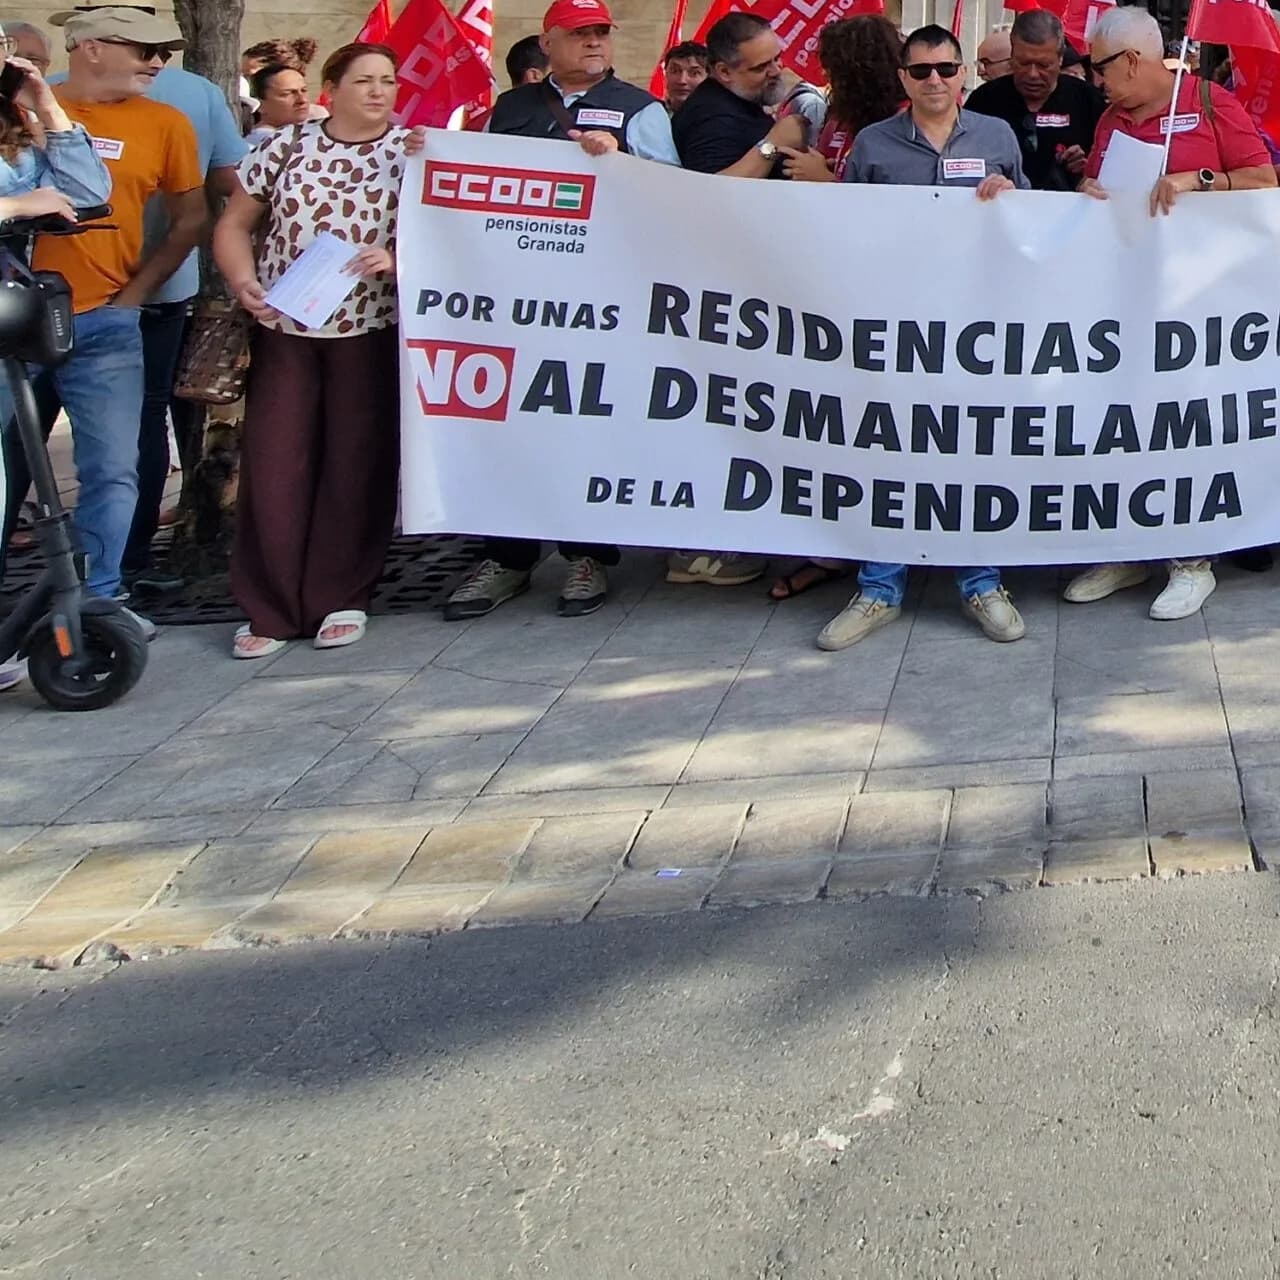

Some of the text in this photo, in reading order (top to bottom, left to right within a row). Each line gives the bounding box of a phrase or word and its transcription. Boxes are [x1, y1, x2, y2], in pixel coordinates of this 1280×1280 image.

[431, 171, 553, 207] CCOO
[485, 218, 587, 236] pensionistas
[517, 235, 585, 254] Granada
[416, 288, 495, 324] POR
[512, 297, 620, 331] UNAS
[647, 282, 1121, 375] RESIDENCIAS
[409, 346, 508, 410] NO
[519, 359, 614, 416] AL
[586, 457, 1243, 532] DE LA DEPENDENCIA
